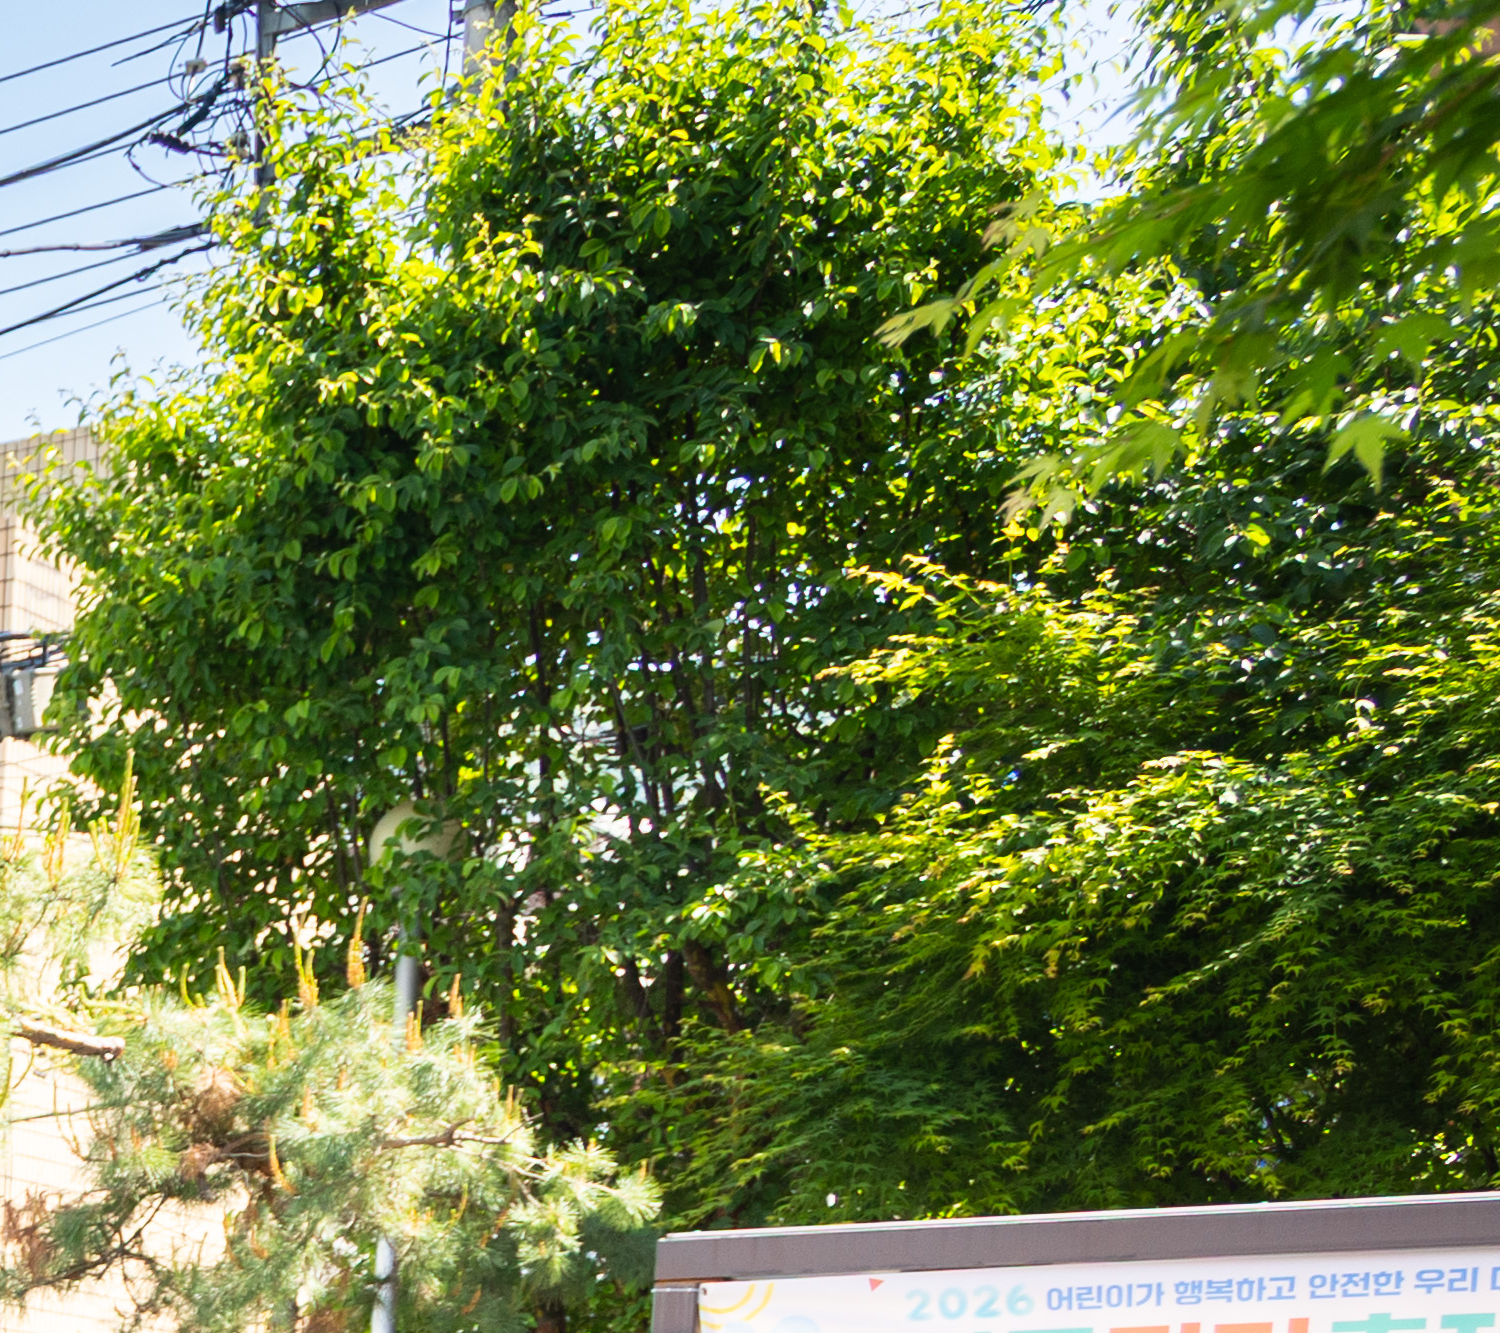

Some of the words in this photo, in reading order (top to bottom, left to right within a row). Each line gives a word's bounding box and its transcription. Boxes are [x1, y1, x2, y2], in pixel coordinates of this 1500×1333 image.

[904, 1283, 1035, 1322] 2026
[1046, 1283, 1164, 1312] 어린이가
[1173, 1276, 1297, 1305] 행복하고
[1308, 1270, 1405, 1300] 안전한
[1413, 1266, 1478, 1296] 우리
